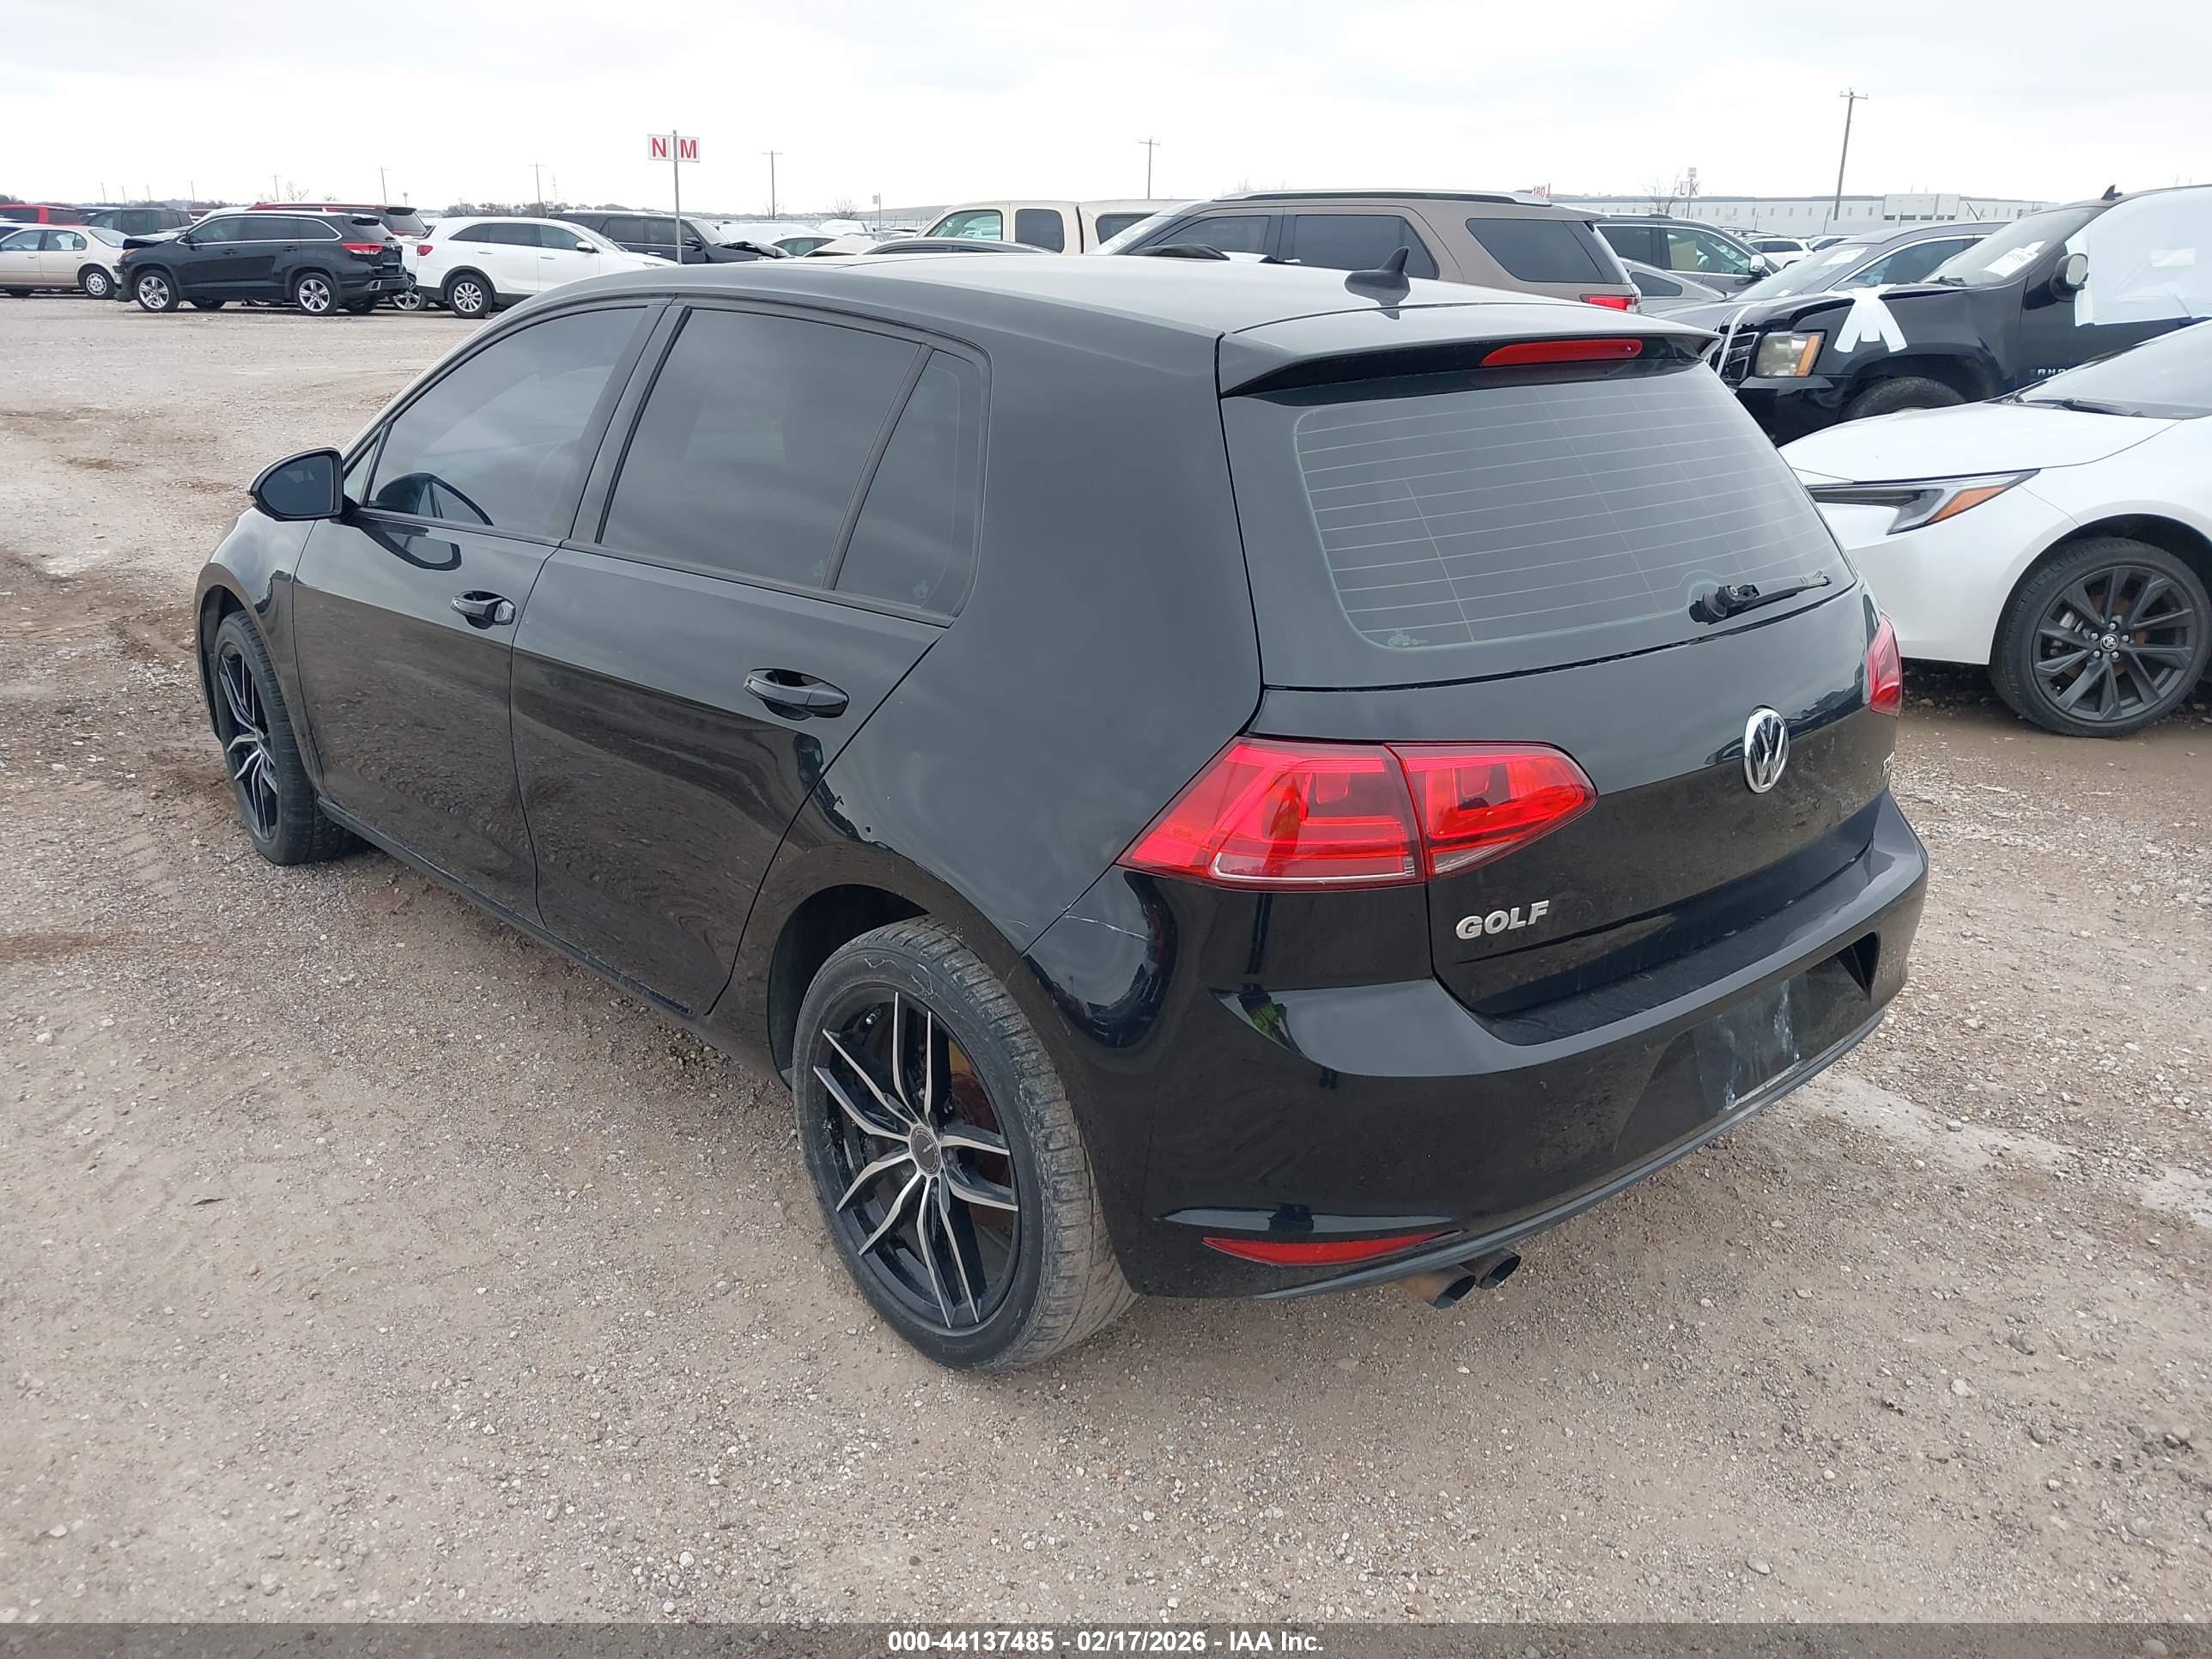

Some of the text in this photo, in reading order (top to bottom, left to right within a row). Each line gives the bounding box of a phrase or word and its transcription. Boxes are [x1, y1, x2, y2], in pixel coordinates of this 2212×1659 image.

[652, 137, 696, 159] N M
[1455, 900, 1550, 939] GOLF
